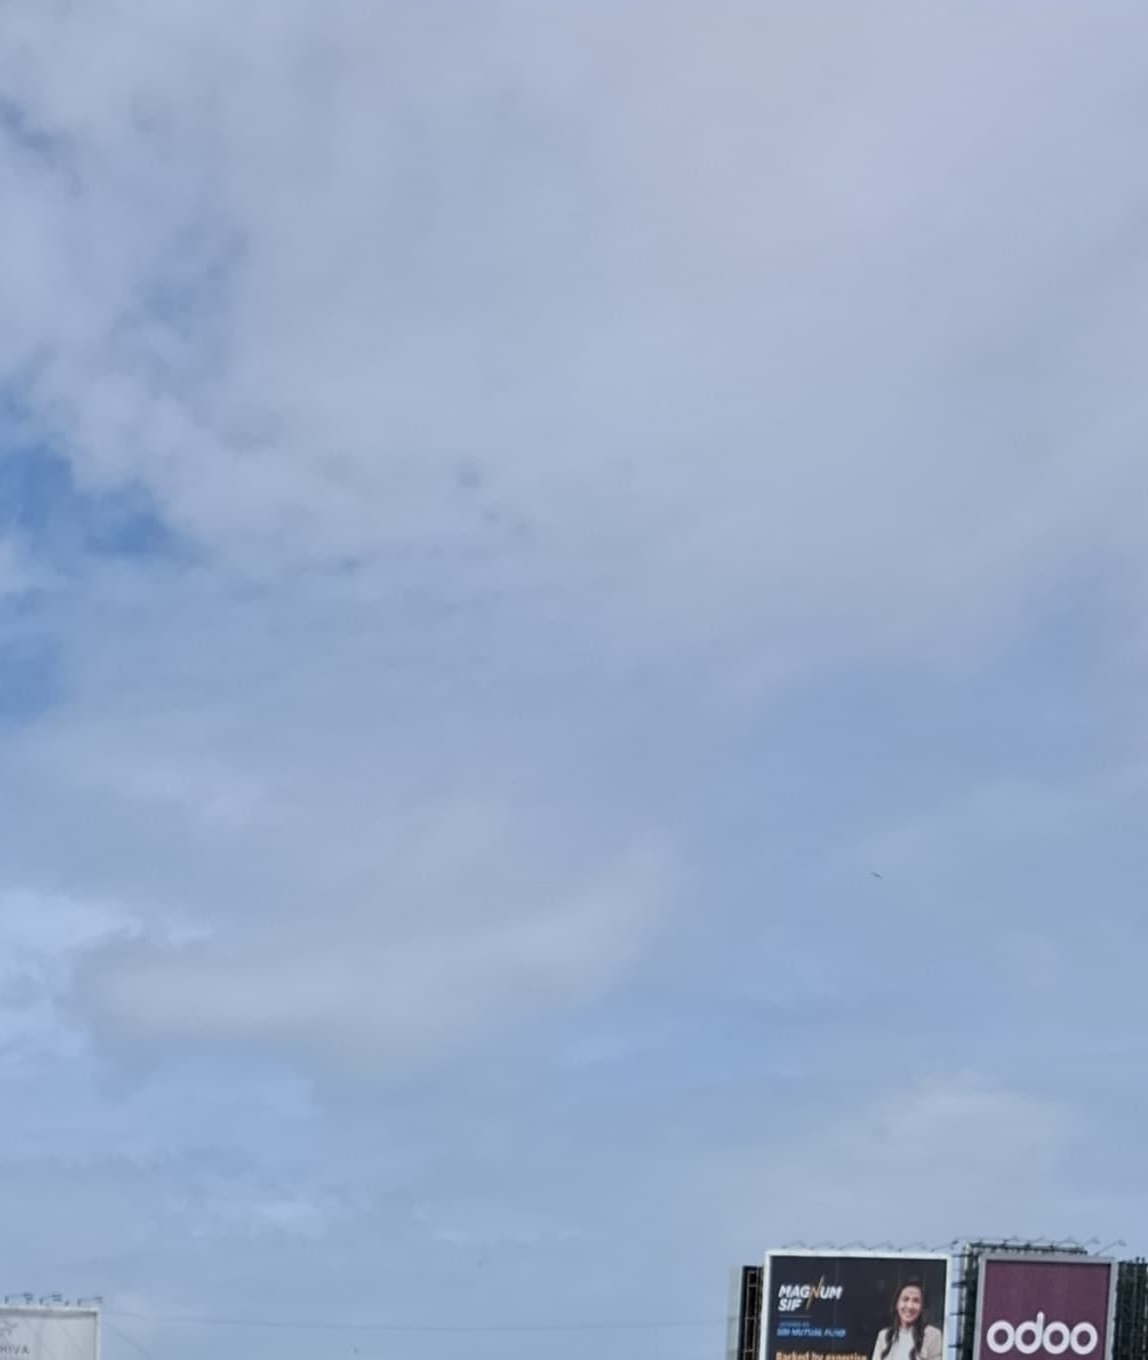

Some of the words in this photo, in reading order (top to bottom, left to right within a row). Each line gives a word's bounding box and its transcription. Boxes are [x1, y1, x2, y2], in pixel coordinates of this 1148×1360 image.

[778, 1280, 843, 1302] MAGNUM
[778, 1298, 802, 1311] SIF
[986, 1311, 1098, 1355] odoo
